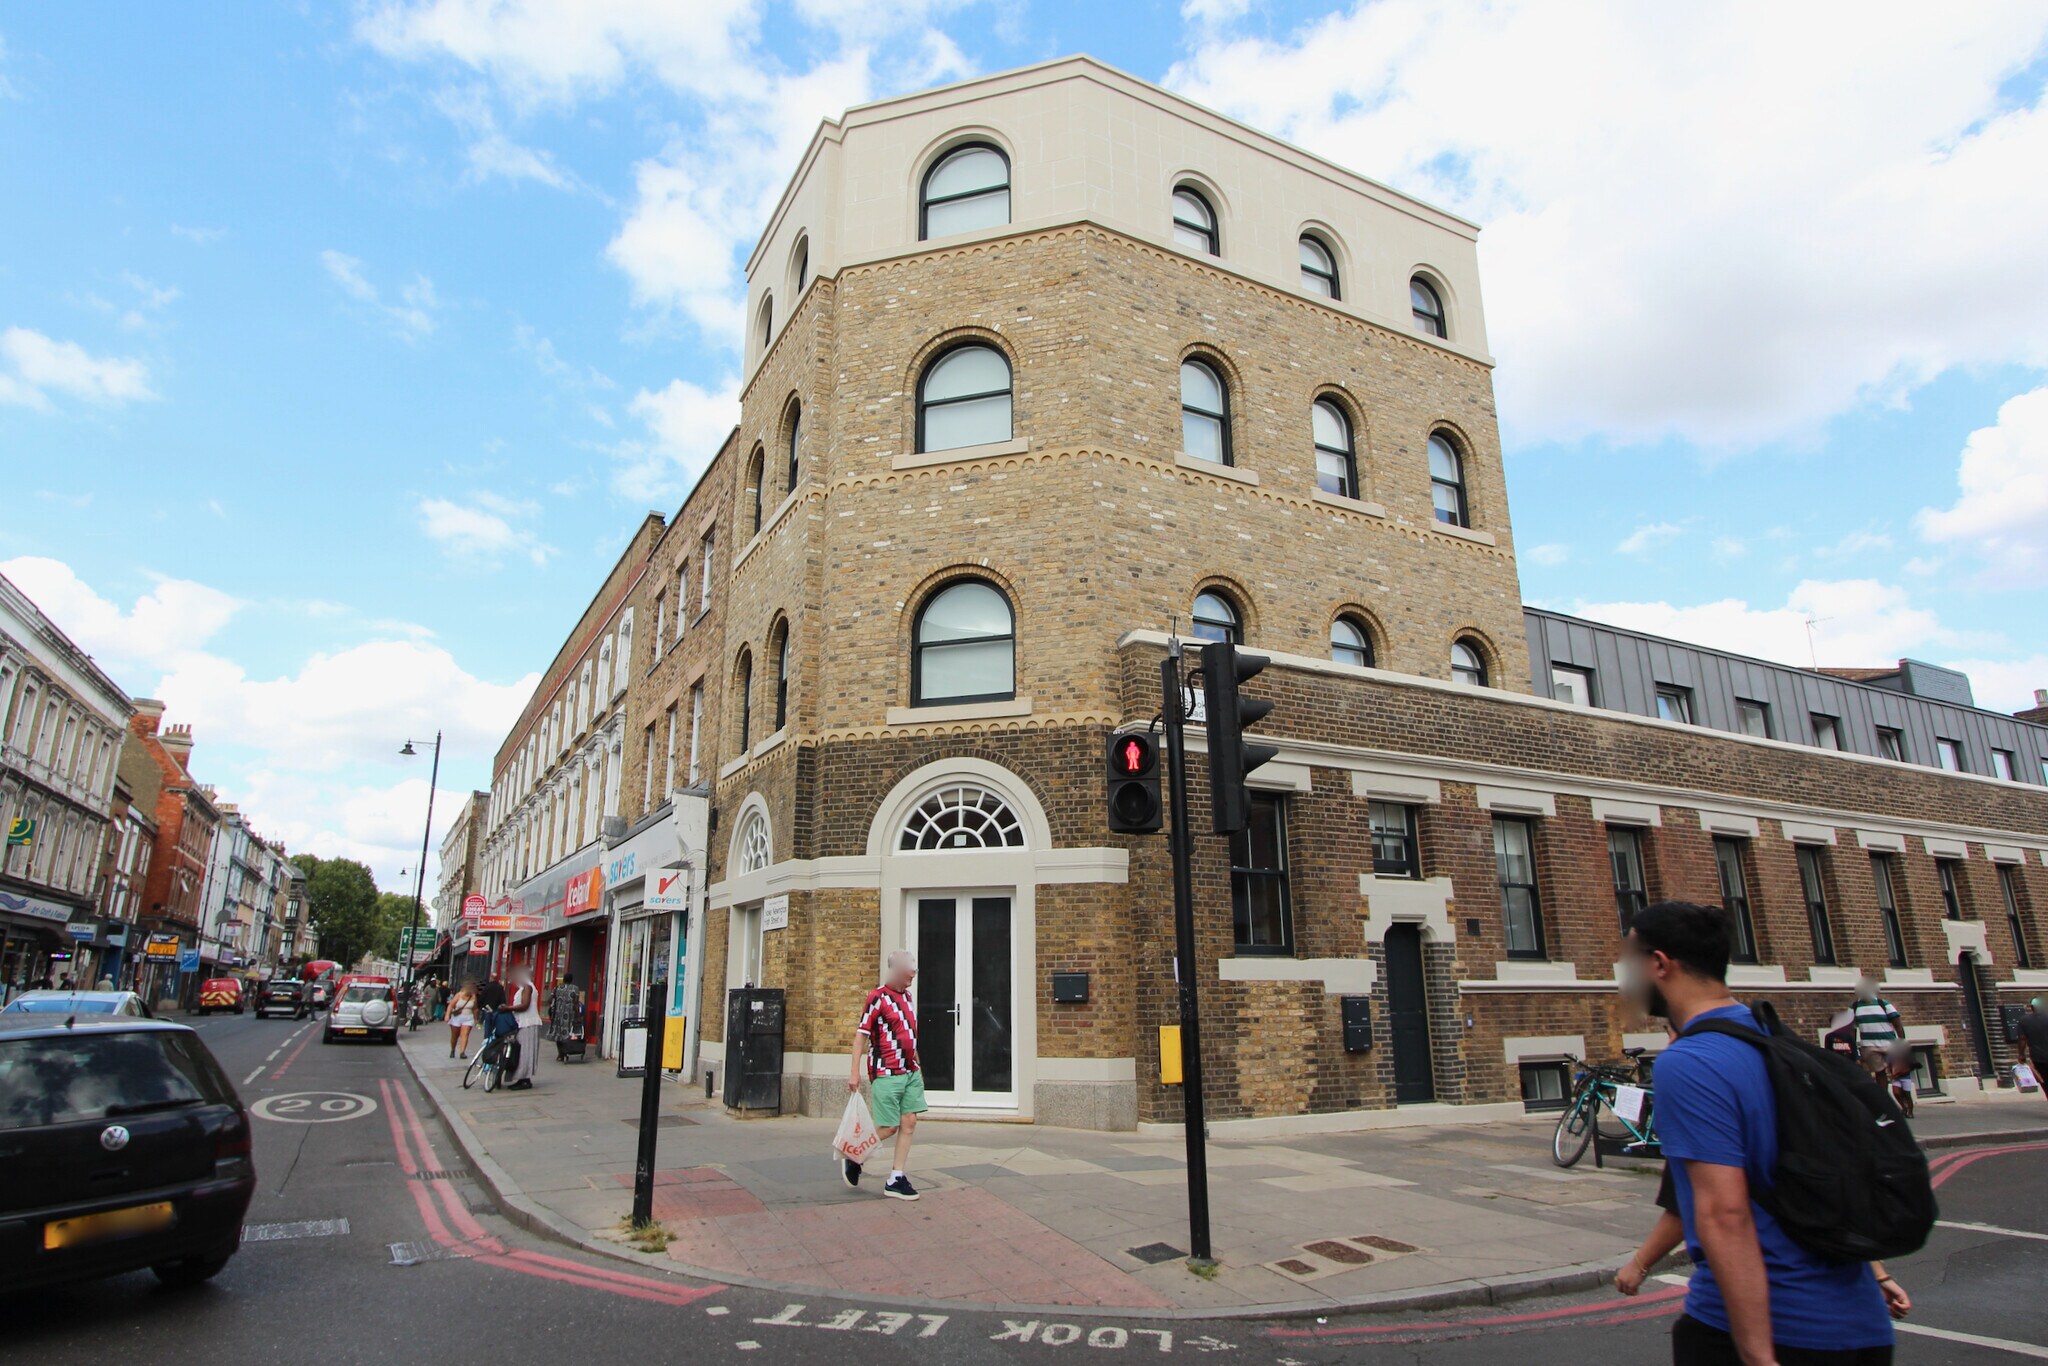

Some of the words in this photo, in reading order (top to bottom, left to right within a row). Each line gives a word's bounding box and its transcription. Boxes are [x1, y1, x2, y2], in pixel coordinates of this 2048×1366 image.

[610, 851, 635, 884] savers
[567, 875, 590, 908] Iceland
[649, 895, 681, 905] savers
[480, 918, 510, 927] Iceland
[275, 1099, 356, 1112] 20
[752, 1304, 950, 1338] LEFT
[989, 1319, 1173, 1352] LOOK
